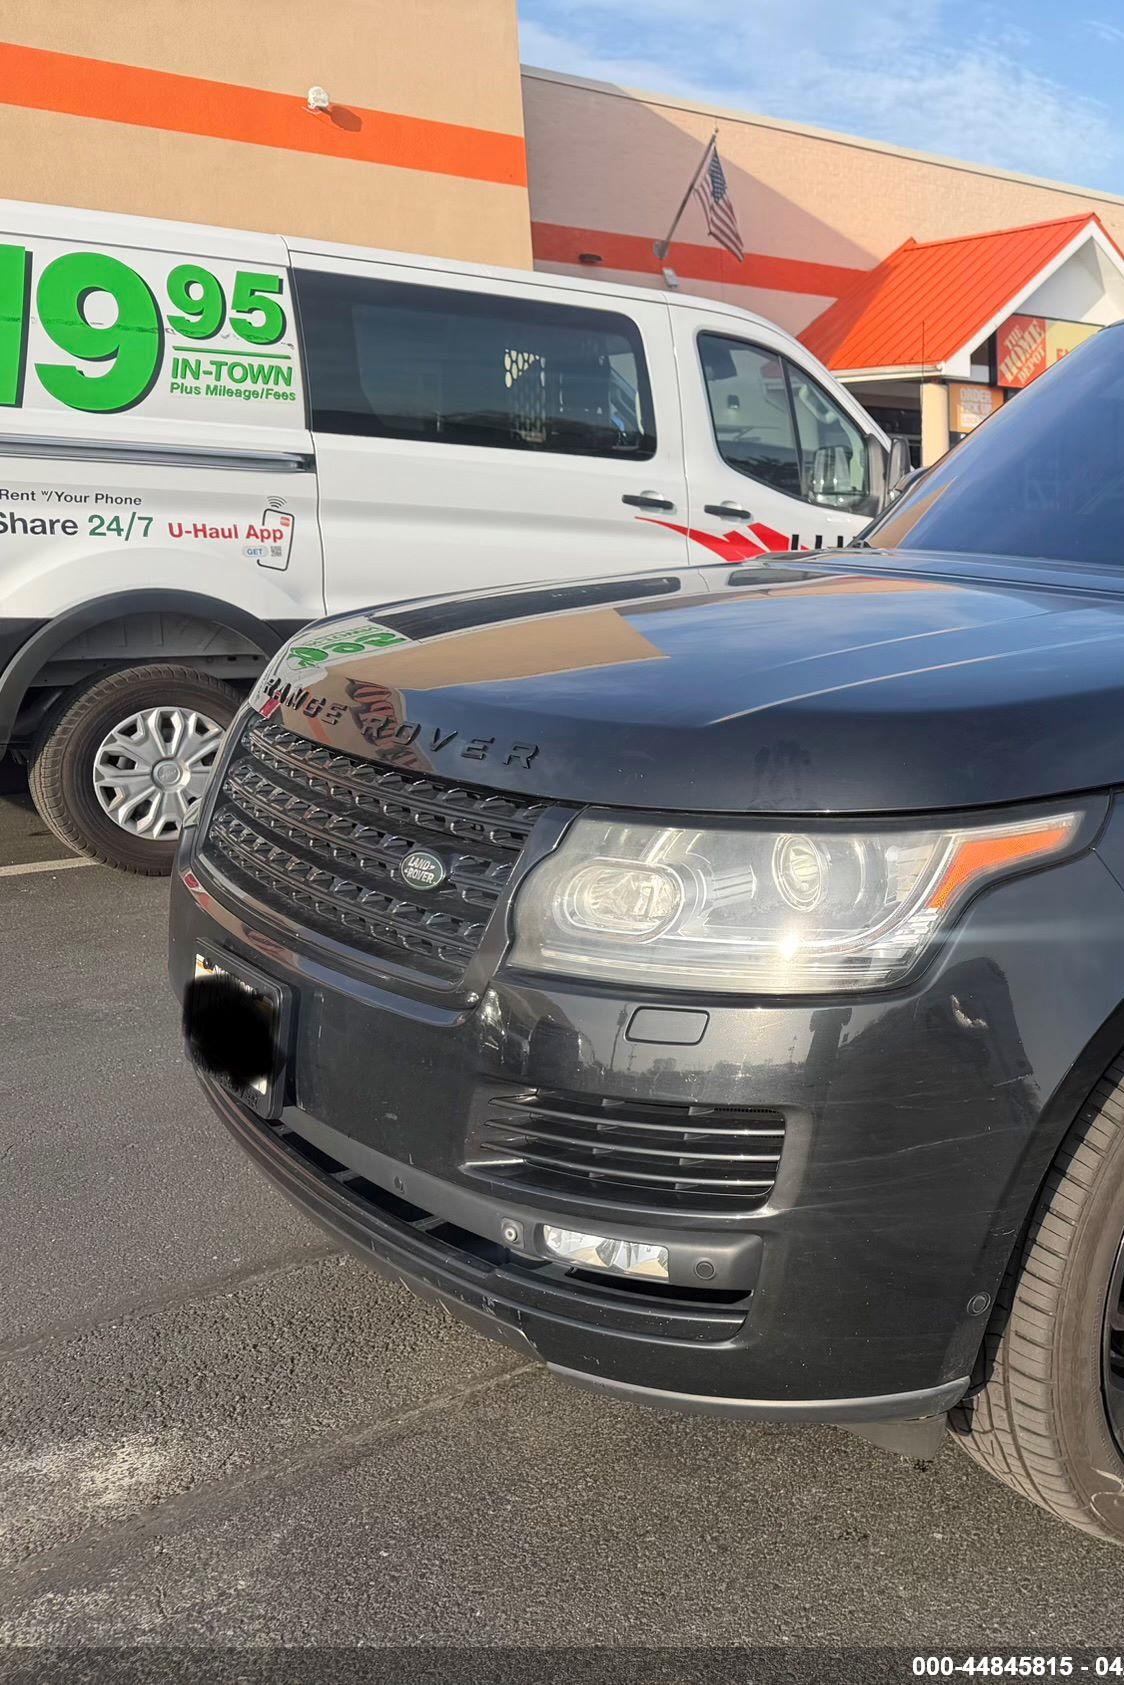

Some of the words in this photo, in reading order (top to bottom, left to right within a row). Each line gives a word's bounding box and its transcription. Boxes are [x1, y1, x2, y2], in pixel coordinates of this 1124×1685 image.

[167, 264, 287, 345] 95
[1004, 325, 1024, 349] THE
[1000, 318, 1043, 382] HOME
[172, 357, 293, 386] IN-TOWN
[1017, 346, 1044, 384] DEPOT
[170, 382, 201, 395] Plus
[205, 384, 296, 401] Mileage/Fees
[0, 489, 36, 501] Rent
[95, 493, 142, 505] Phone
[88, 512, 154, 542] 24/7
[168, 522, 239, 540] U-Haul
[245, 525, 284, 543] App
[246, 548, 263, 556] GET
[263, 676, 348, 726] RANGE
[361, 714, 540, 769] ROVER
[408, 856, 431, 870] LAND
[406, 868, 435, 883] ROVER
